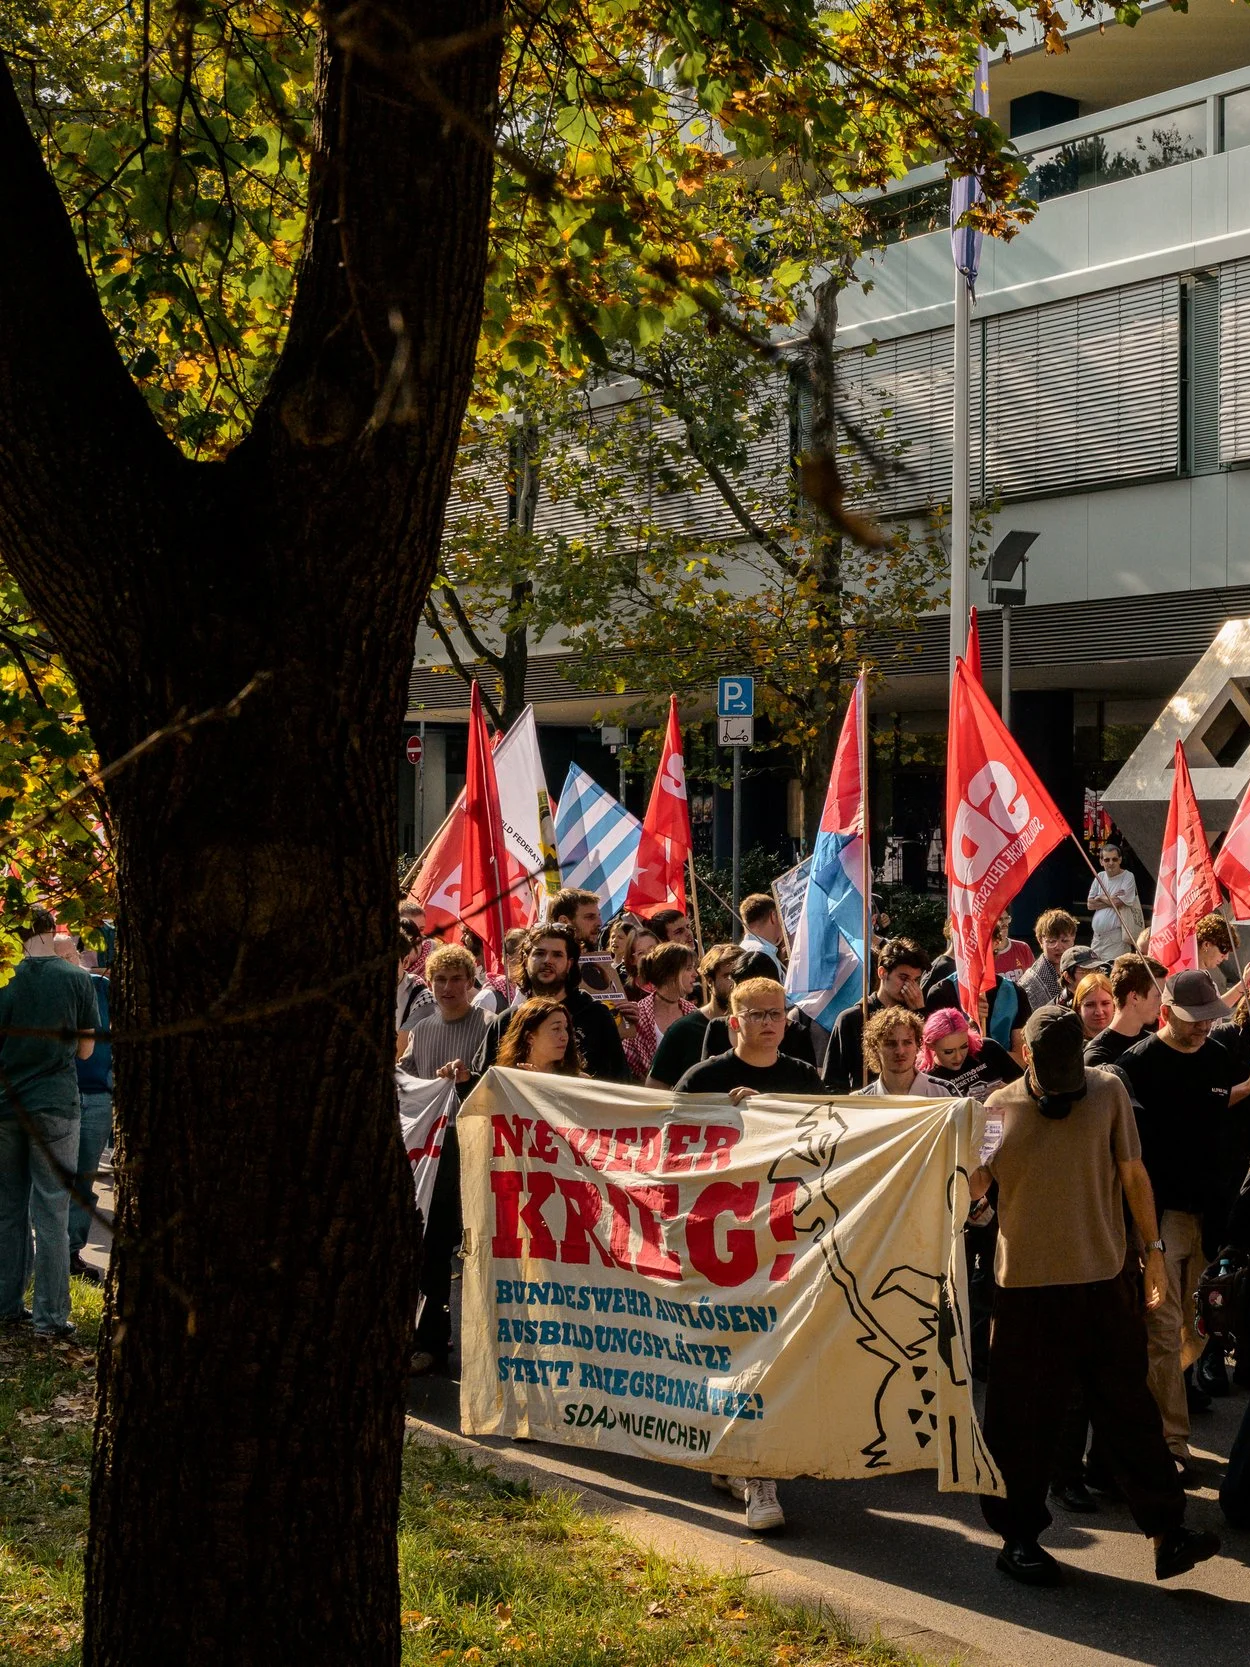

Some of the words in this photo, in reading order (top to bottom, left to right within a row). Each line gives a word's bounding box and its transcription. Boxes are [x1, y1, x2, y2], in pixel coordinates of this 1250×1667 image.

[724, 682, 743, 711] P
[512, 832, 544, 869] FEDERATI
[490, 1113, 559, 1166] NIE
[556, 1123, 741, 1174] WIEDER
[489, 1170, 800, 1288] KRIEG!
[496, 1279, 653, 1318] BUNDESWEHR
[654, 1296, 778, 1334] AUFLÖSEN!
[496, 1318, 733, 1373] AUSBILDUNGSPLÄTZE
[496, 1355, 574, 1388] STATT
[618, 1410, 712, 1454] MUENCHEN
